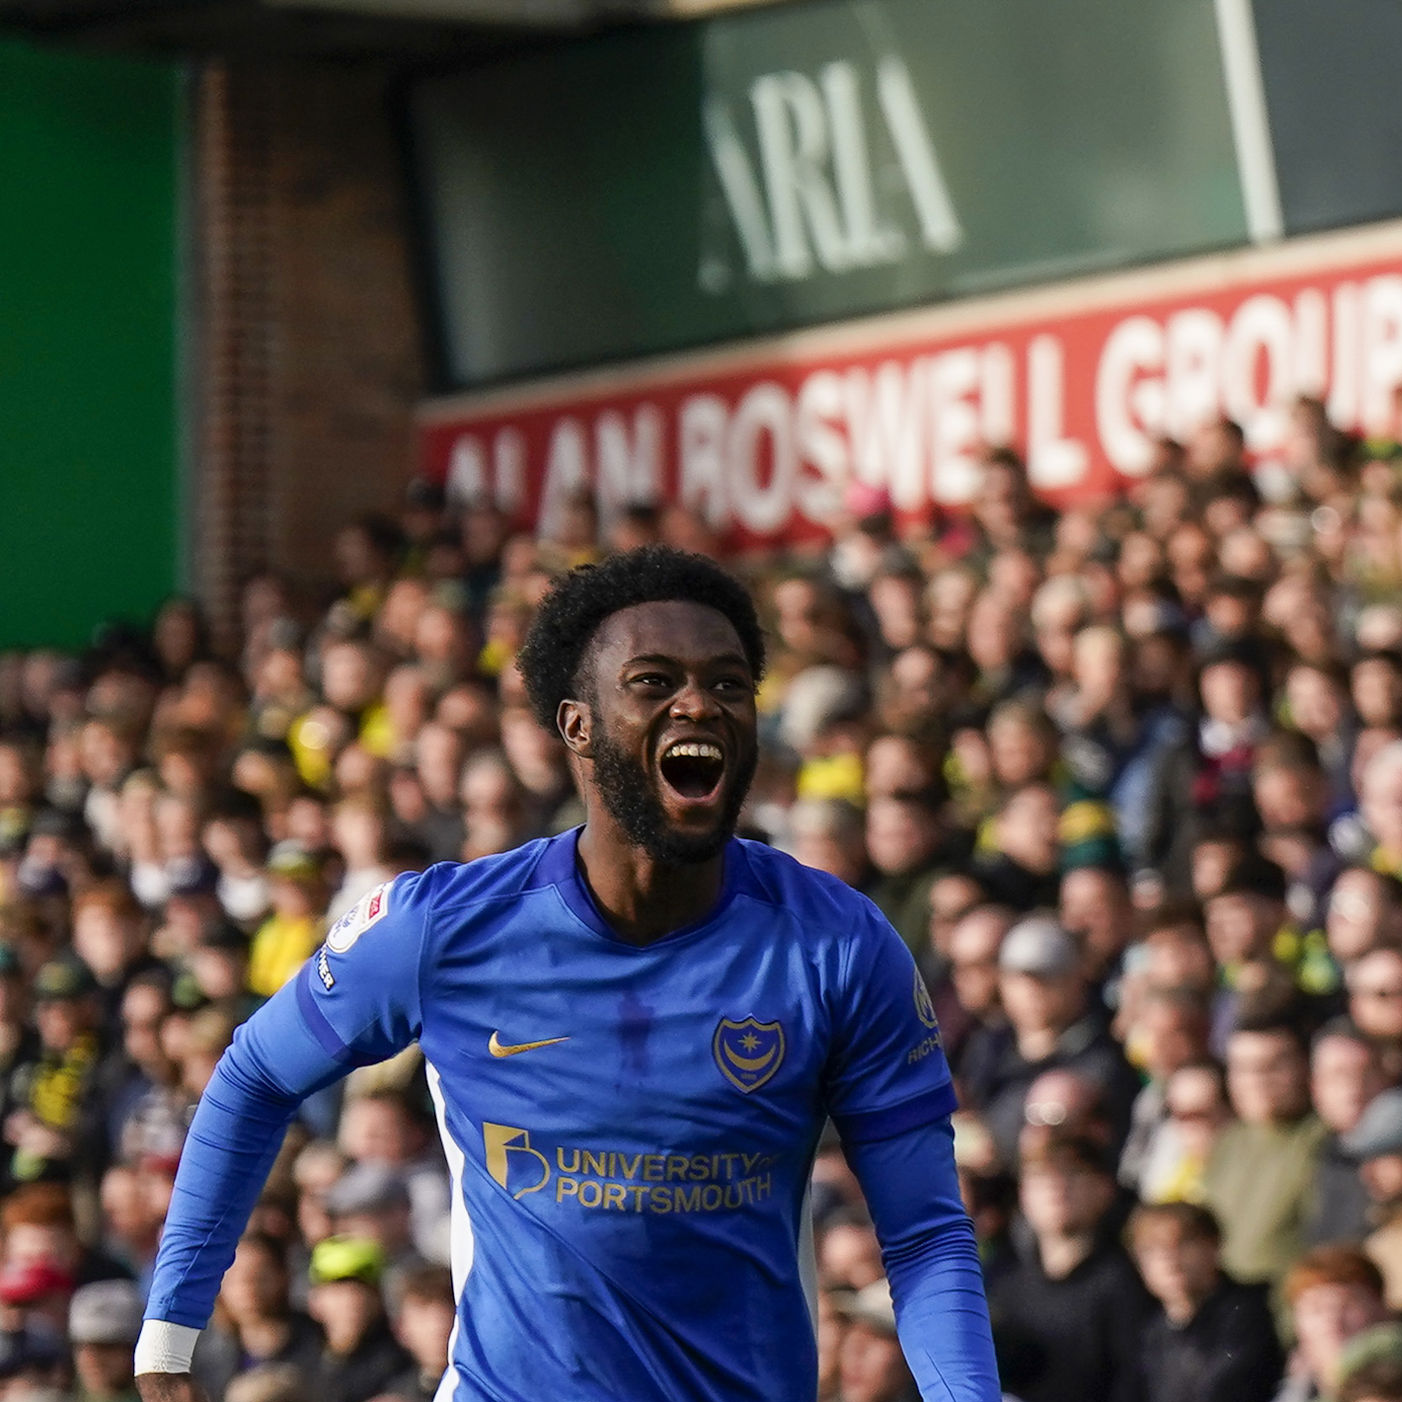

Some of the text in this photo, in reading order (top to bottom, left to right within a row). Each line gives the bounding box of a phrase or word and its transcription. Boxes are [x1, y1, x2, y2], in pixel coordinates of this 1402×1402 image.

[678, 333, 1089, 536] BOSWELL
[556, 1146, 760, 1181] UNIVERSITY
[555, 1172, 772, 1215] PORTSMOUTH
